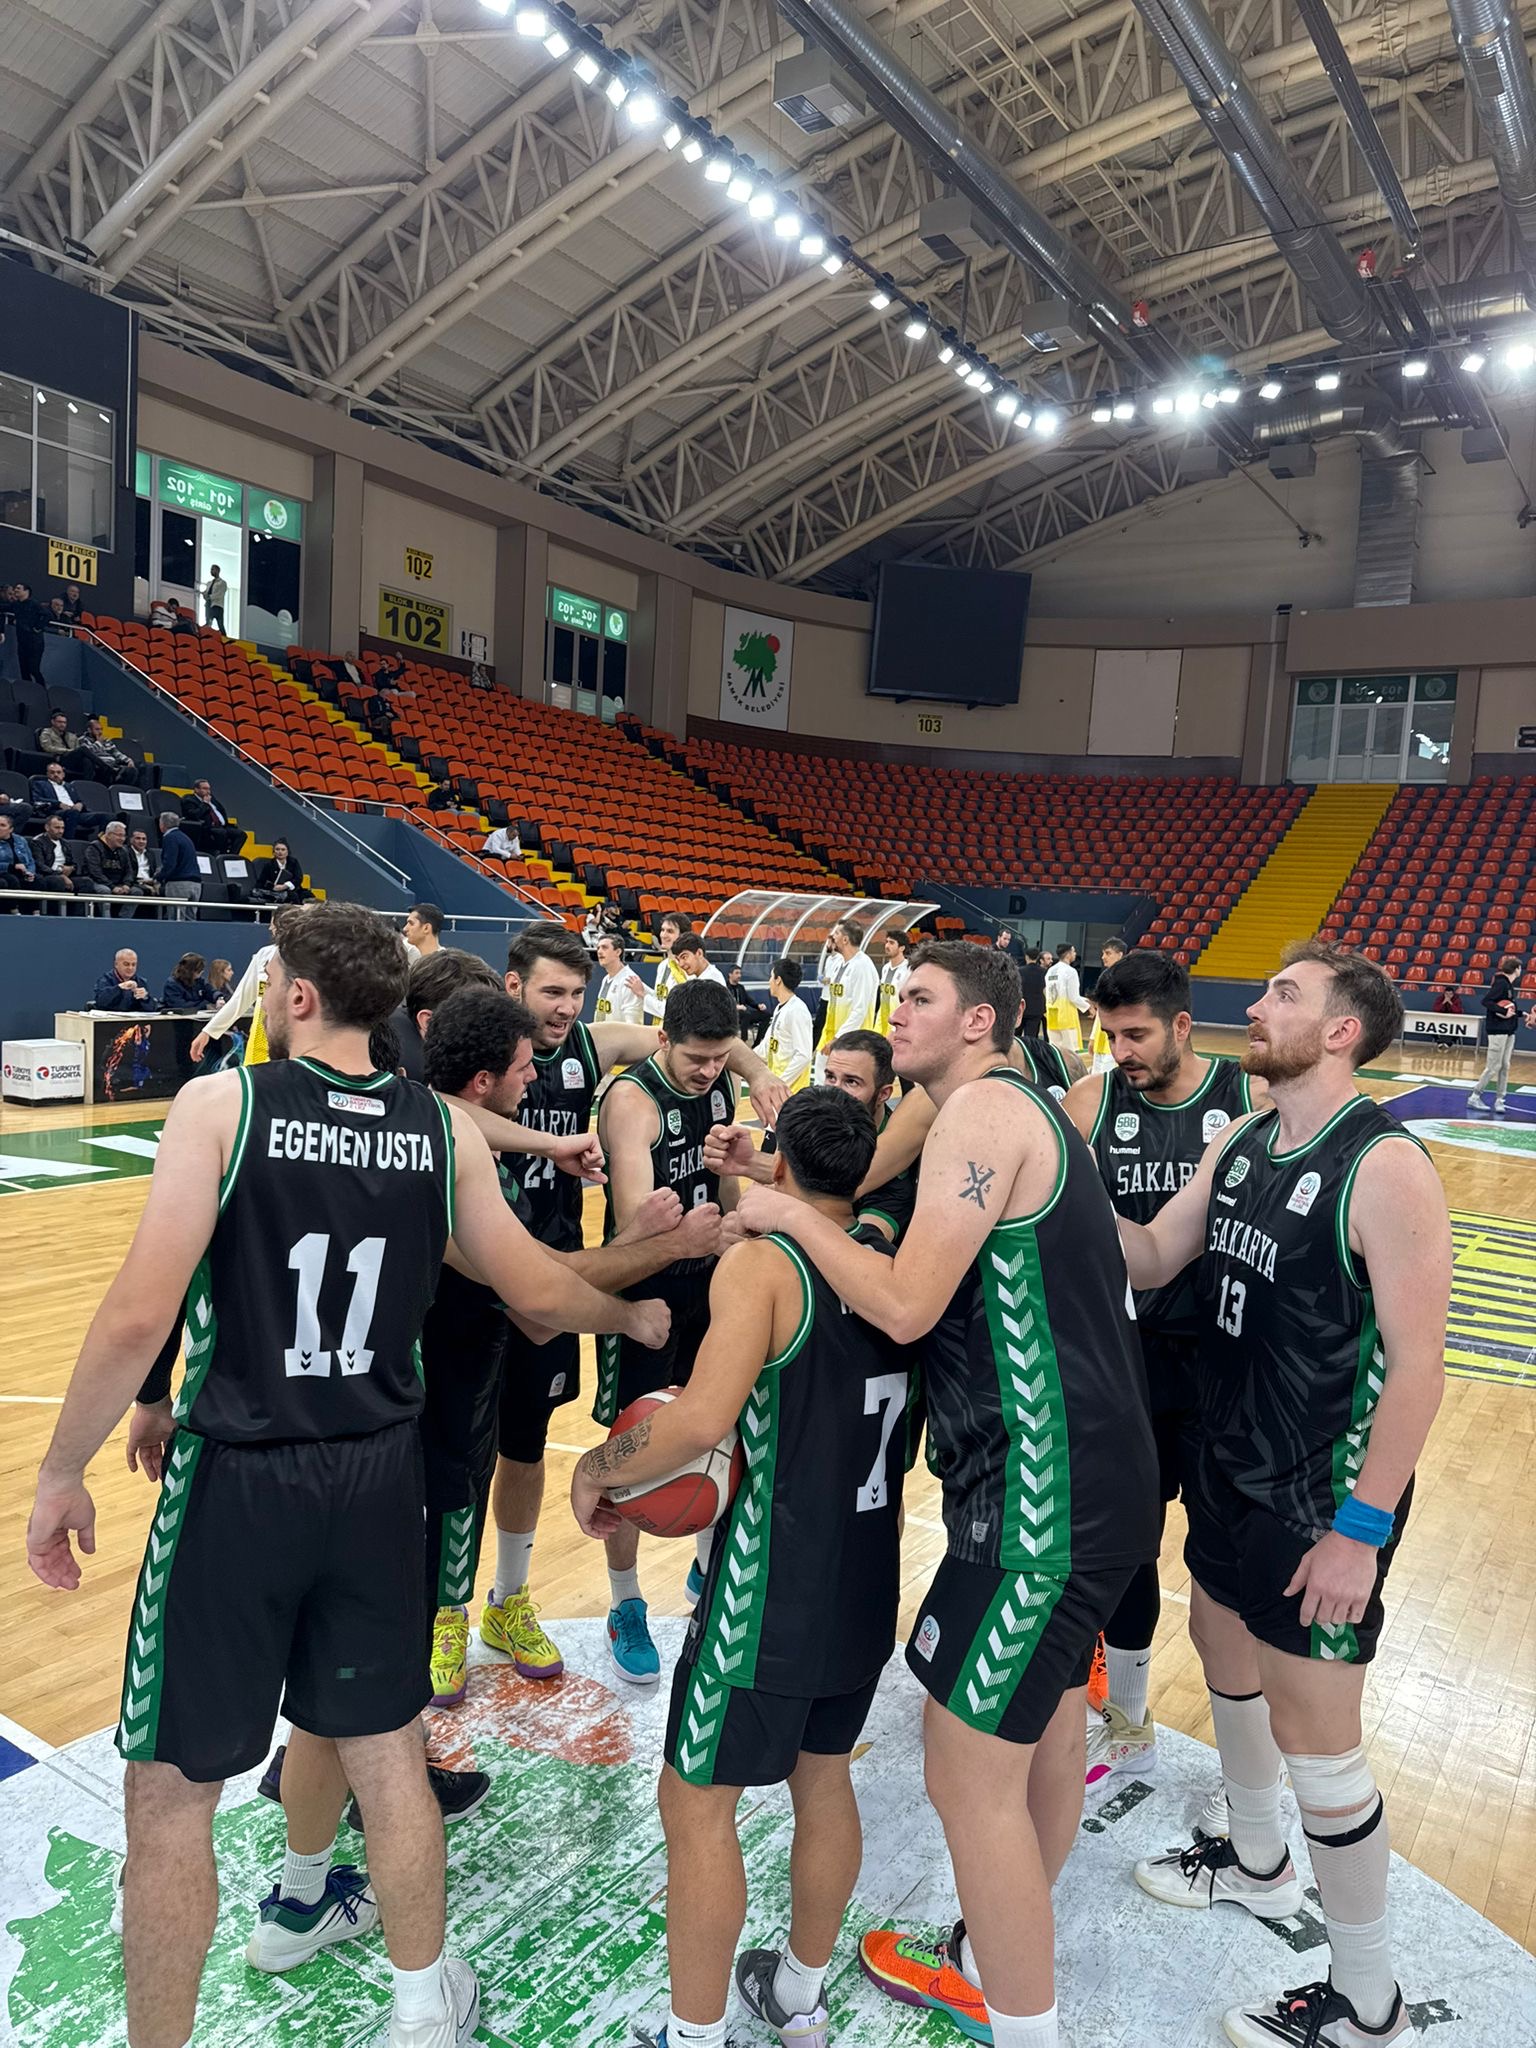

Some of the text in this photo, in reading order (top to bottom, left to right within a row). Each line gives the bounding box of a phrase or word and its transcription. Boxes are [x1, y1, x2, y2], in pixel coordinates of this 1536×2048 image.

[54, 551, 92, 582] 101
[406, 555, 432, 579] 102
[385, 606, 441, 648] 102
[727, 672, 743, 706] MAMAK
[919, 718, 941, 733] 103
[1008, 894, 1027, 915] D
[1415, 1021, 1467, 1036] BASIN
[1117, 1116, 1137, 1129] SBB
[268, 1118, 434, 1172] EGEMEN USTA
[1109, 1145, 1141, 1155] hummel
[1117, 1161, 1199, 1196] SAKAR
[1209, 1217, 1279, 1283] SAKARYA
[284, 1232, 387, 1378] 11
[1216, 1274, 1247, 1338] 13
[856, 1371, 908, 1513] 7
